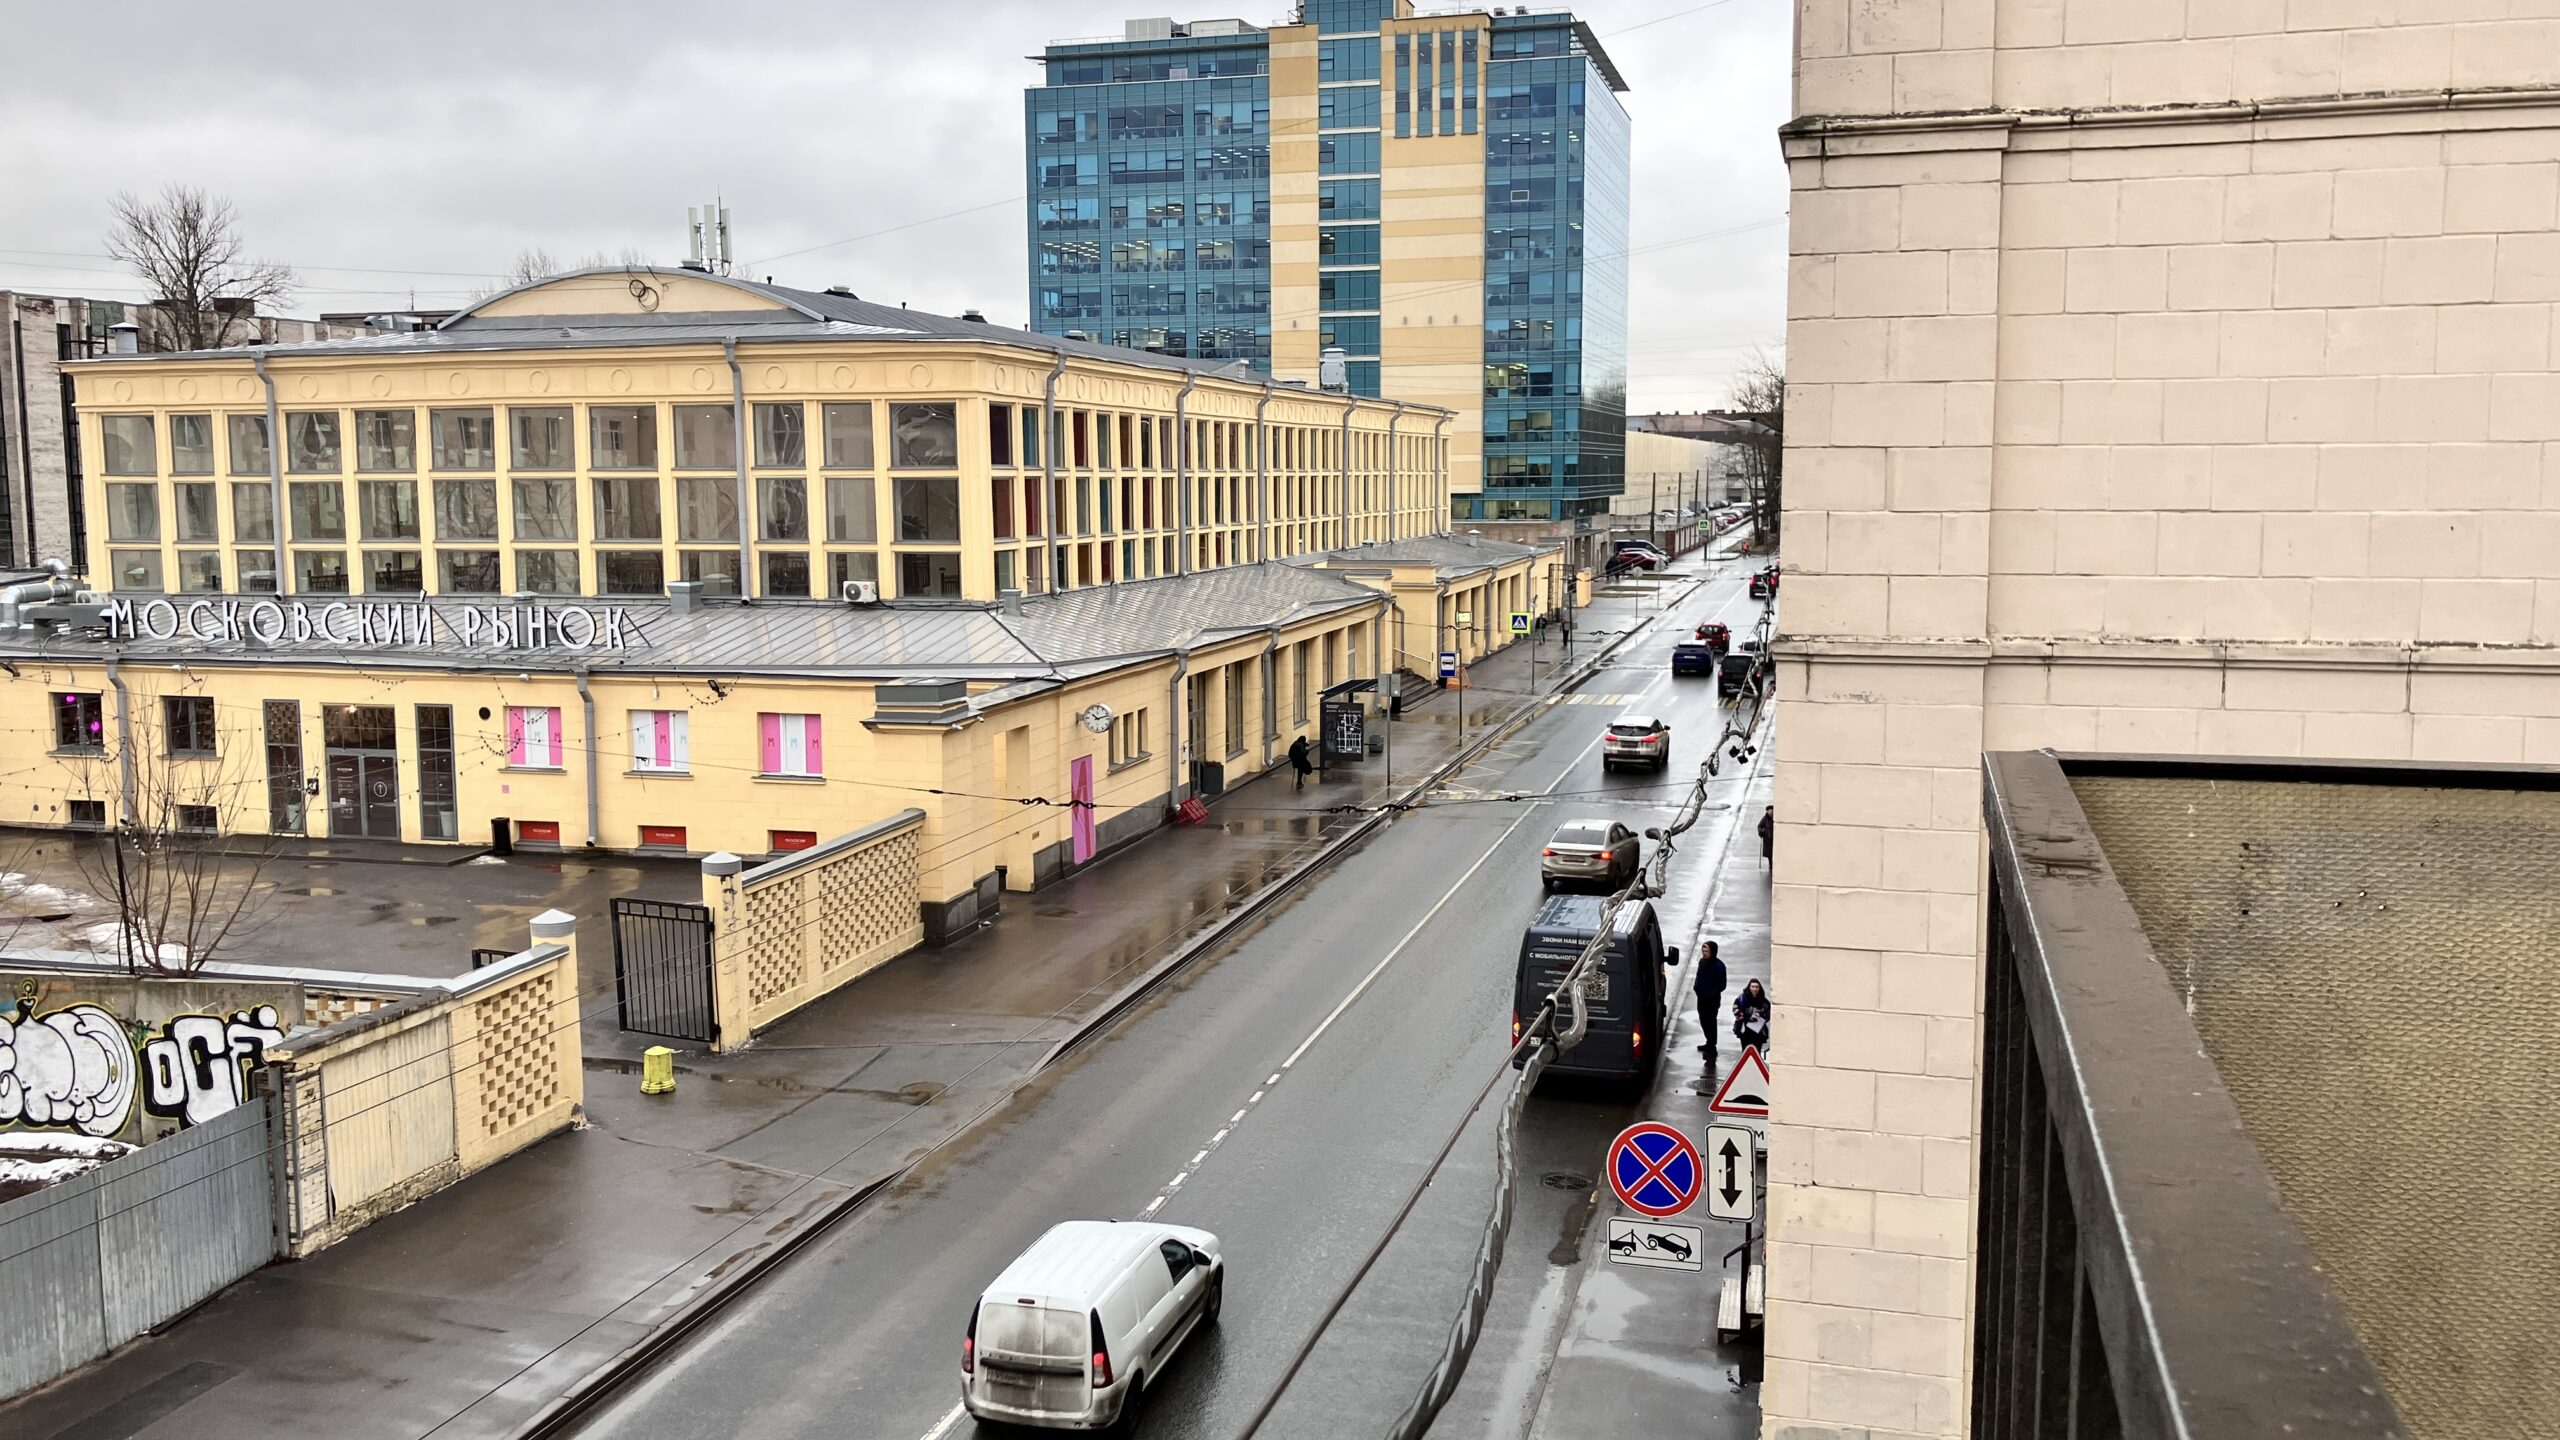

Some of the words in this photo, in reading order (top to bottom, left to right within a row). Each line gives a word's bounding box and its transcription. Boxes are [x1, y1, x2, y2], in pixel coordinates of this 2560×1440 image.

[111, 589, 434, 646] МОСКОВСКИЙ
[464, 606, 627, 650] РЫНОК
[1541, 936, 1563, 944] ЗВОНИ
[1534, 952, 1577, 961] МОБИЛЬНОГО
